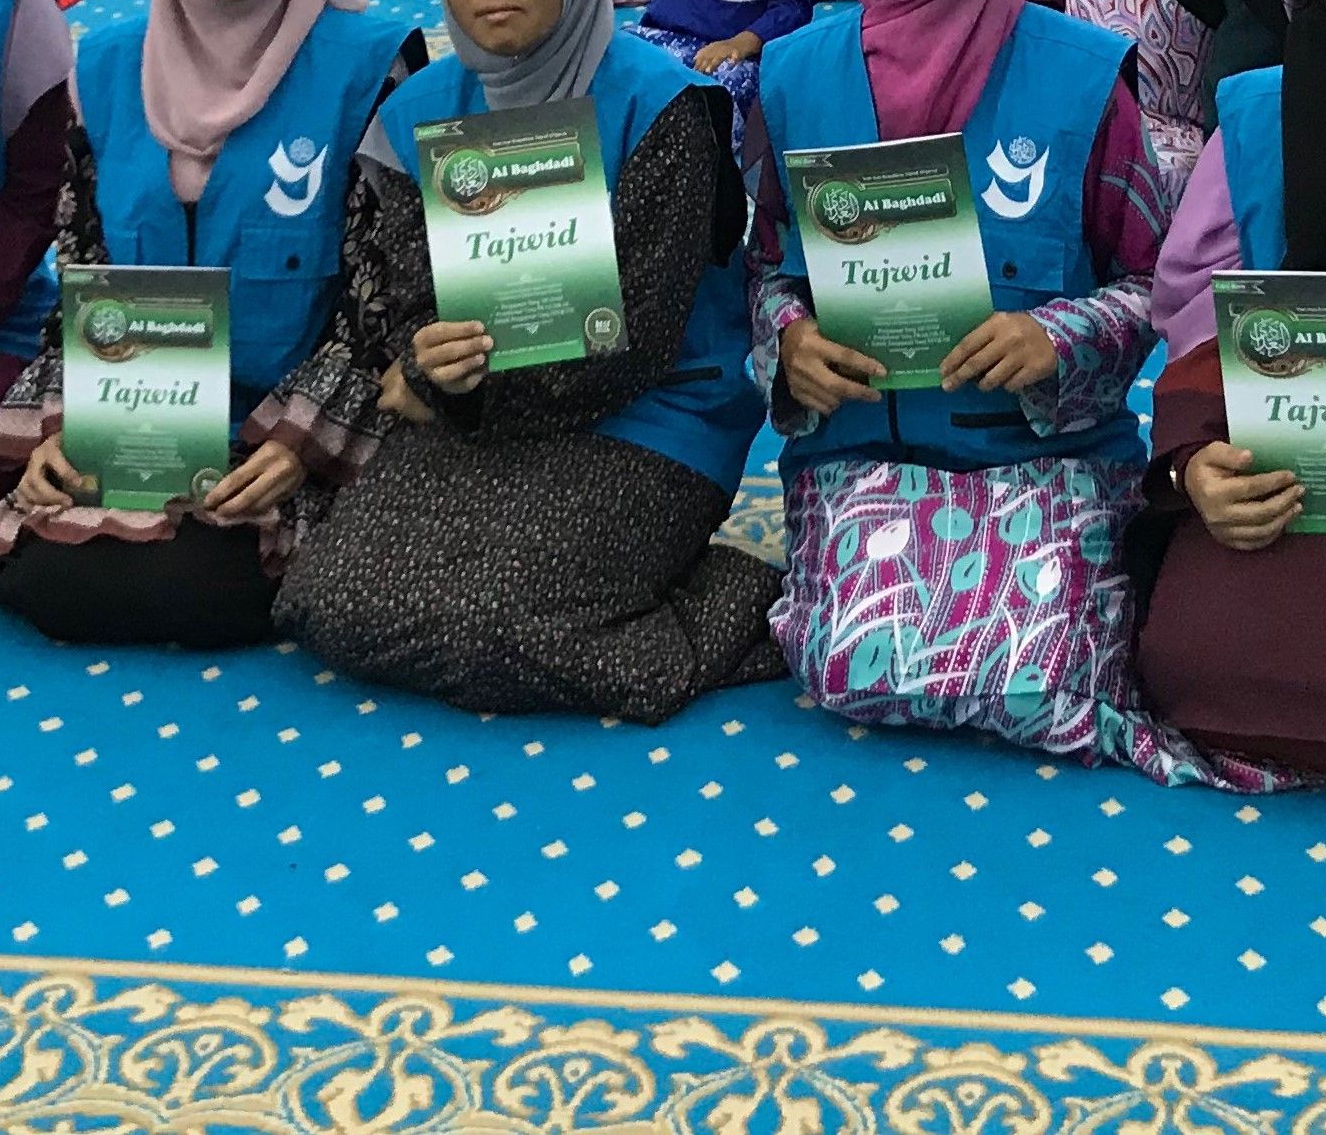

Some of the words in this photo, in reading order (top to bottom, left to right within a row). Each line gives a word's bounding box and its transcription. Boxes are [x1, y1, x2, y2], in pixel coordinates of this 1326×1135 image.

[492, 166, 507, 179] Al
[515, 156, 575, 176] Baghdadi
[864, 200, 880, 211] Al
[882, 192, 946, 210] Baghdadi
[467, 218, 579, 264] Tajwid
[842, 251, 952, 292] Tajwid
[129, 320, 144, 332] Al
[147, 320, 206, 335] Baghdadi
[1295, 333, 1312, 344] Al
[98, 378, 200, 411] Tajwid
